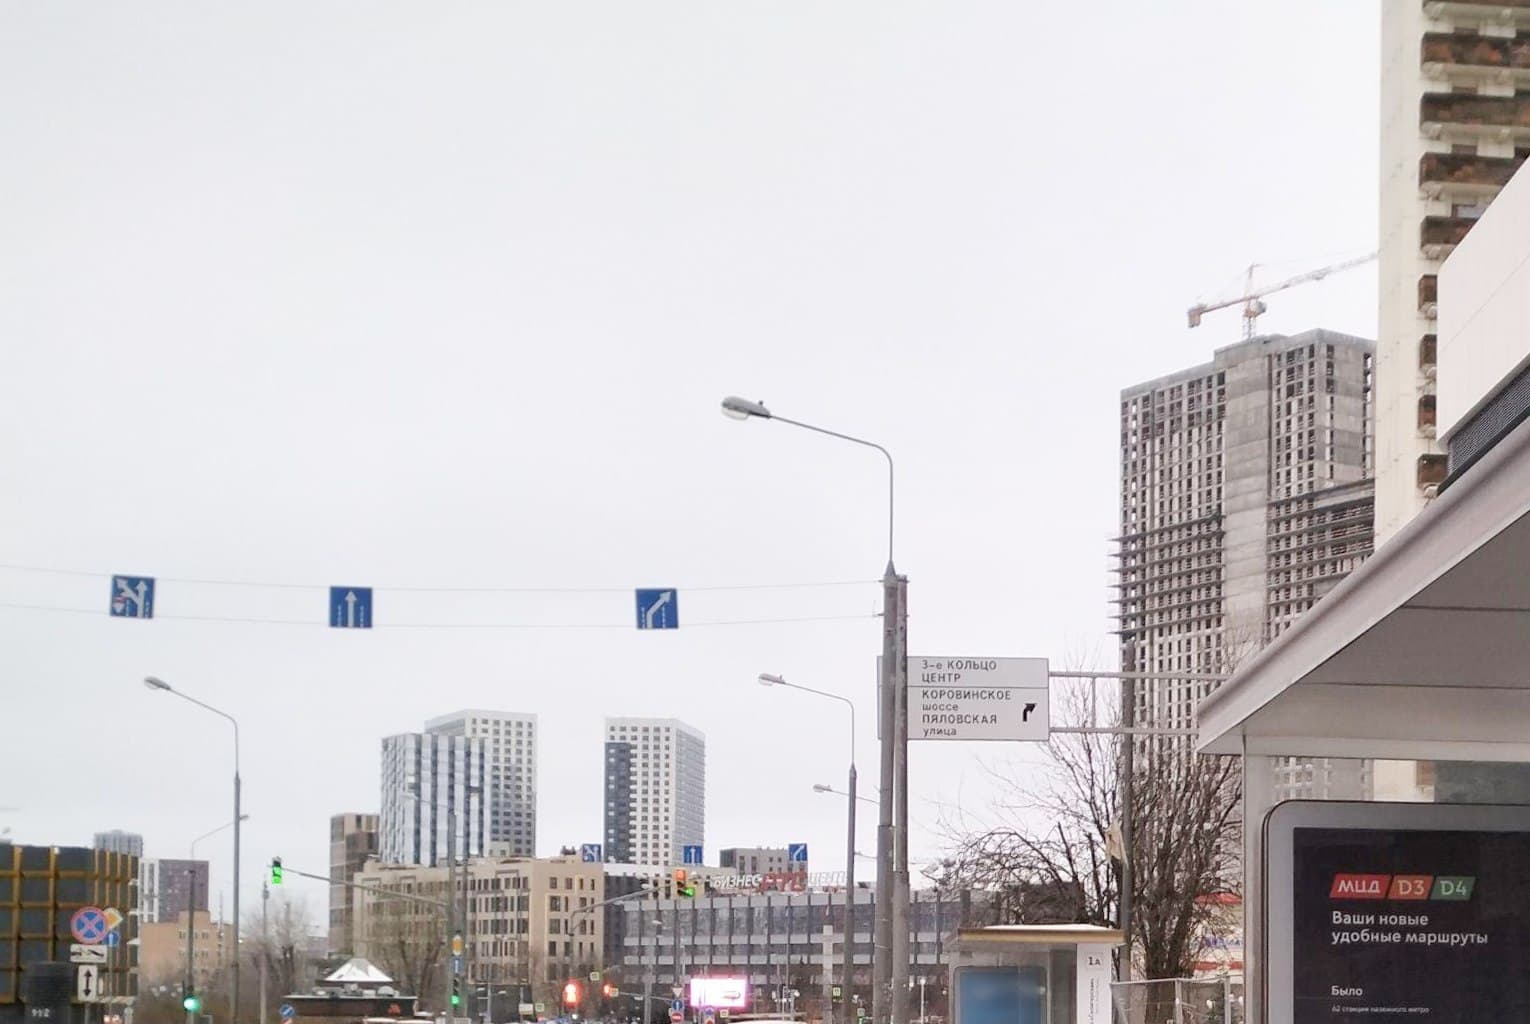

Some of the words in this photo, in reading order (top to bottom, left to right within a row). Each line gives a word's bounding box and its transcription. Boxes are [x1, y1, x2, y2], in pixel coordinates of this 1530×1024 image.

[921, 660, 943, 670] 3-е
[947, 660, 997, 671] КОЛЬЦО
[921, 672, 961, 684] ЦЕНТР
[922, 689, 1012, 701] КОРОВИНСКОЕ
[922, 703, 959, 712] шоссе
[922, 713, 997, 725] ПЯЛОВСКАЯ
[923, 727, 957, 738] улица
[1337, 879, 1381, 894] МЦД
[1397, 879, 1425, 896] D3
[1440, 880, 1467, 896] D4
[1331, 910, 1375, 925] Ваши
[1379, 914, 1429, 926] новые
[1331, 928, 1401, 945] удобные
[1405, 932, 1489, 946] маршруты
[1331, 985, 1363, 997] Было
